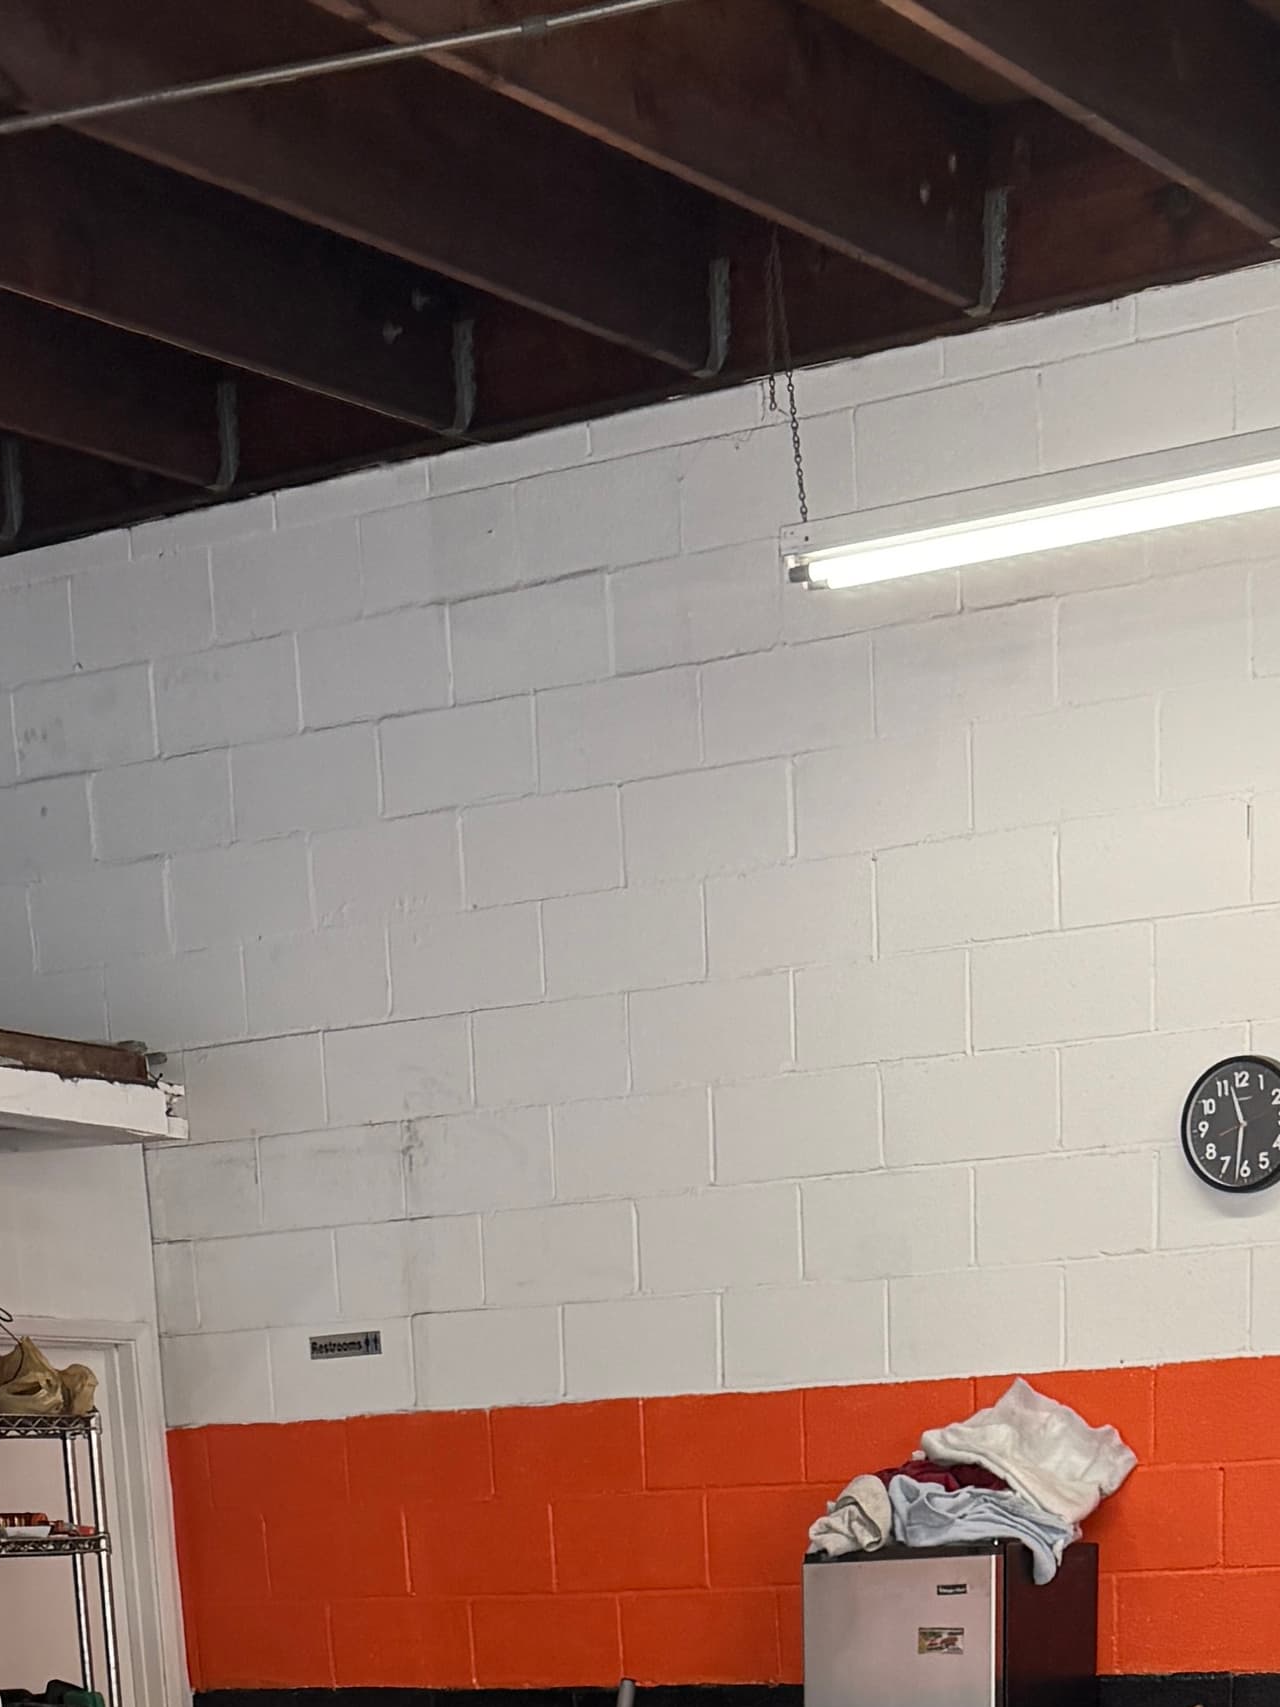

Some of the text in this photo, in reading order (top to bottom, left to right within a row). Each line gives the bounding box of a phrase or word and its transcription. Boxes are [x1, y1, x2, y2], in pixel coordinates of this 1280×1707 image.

[1234, 1071, 1249, 1088] 12
[1258, 1074, 1264, 1090] 1
[1216, 1080, 1229, 1097] 11
[1202, 1098, 1216, 1115] 10
[1198, 1121, 1209, 1138] 9
[1205, 1143, 1217, 1160] 8
[1220, 1155, 1231, 1174] 7
[1240, 1160, 1251, 1178] 6
[1259, 1152, 1270, 1170] 5
[311, 1341, 362, 1354] Restrooms
